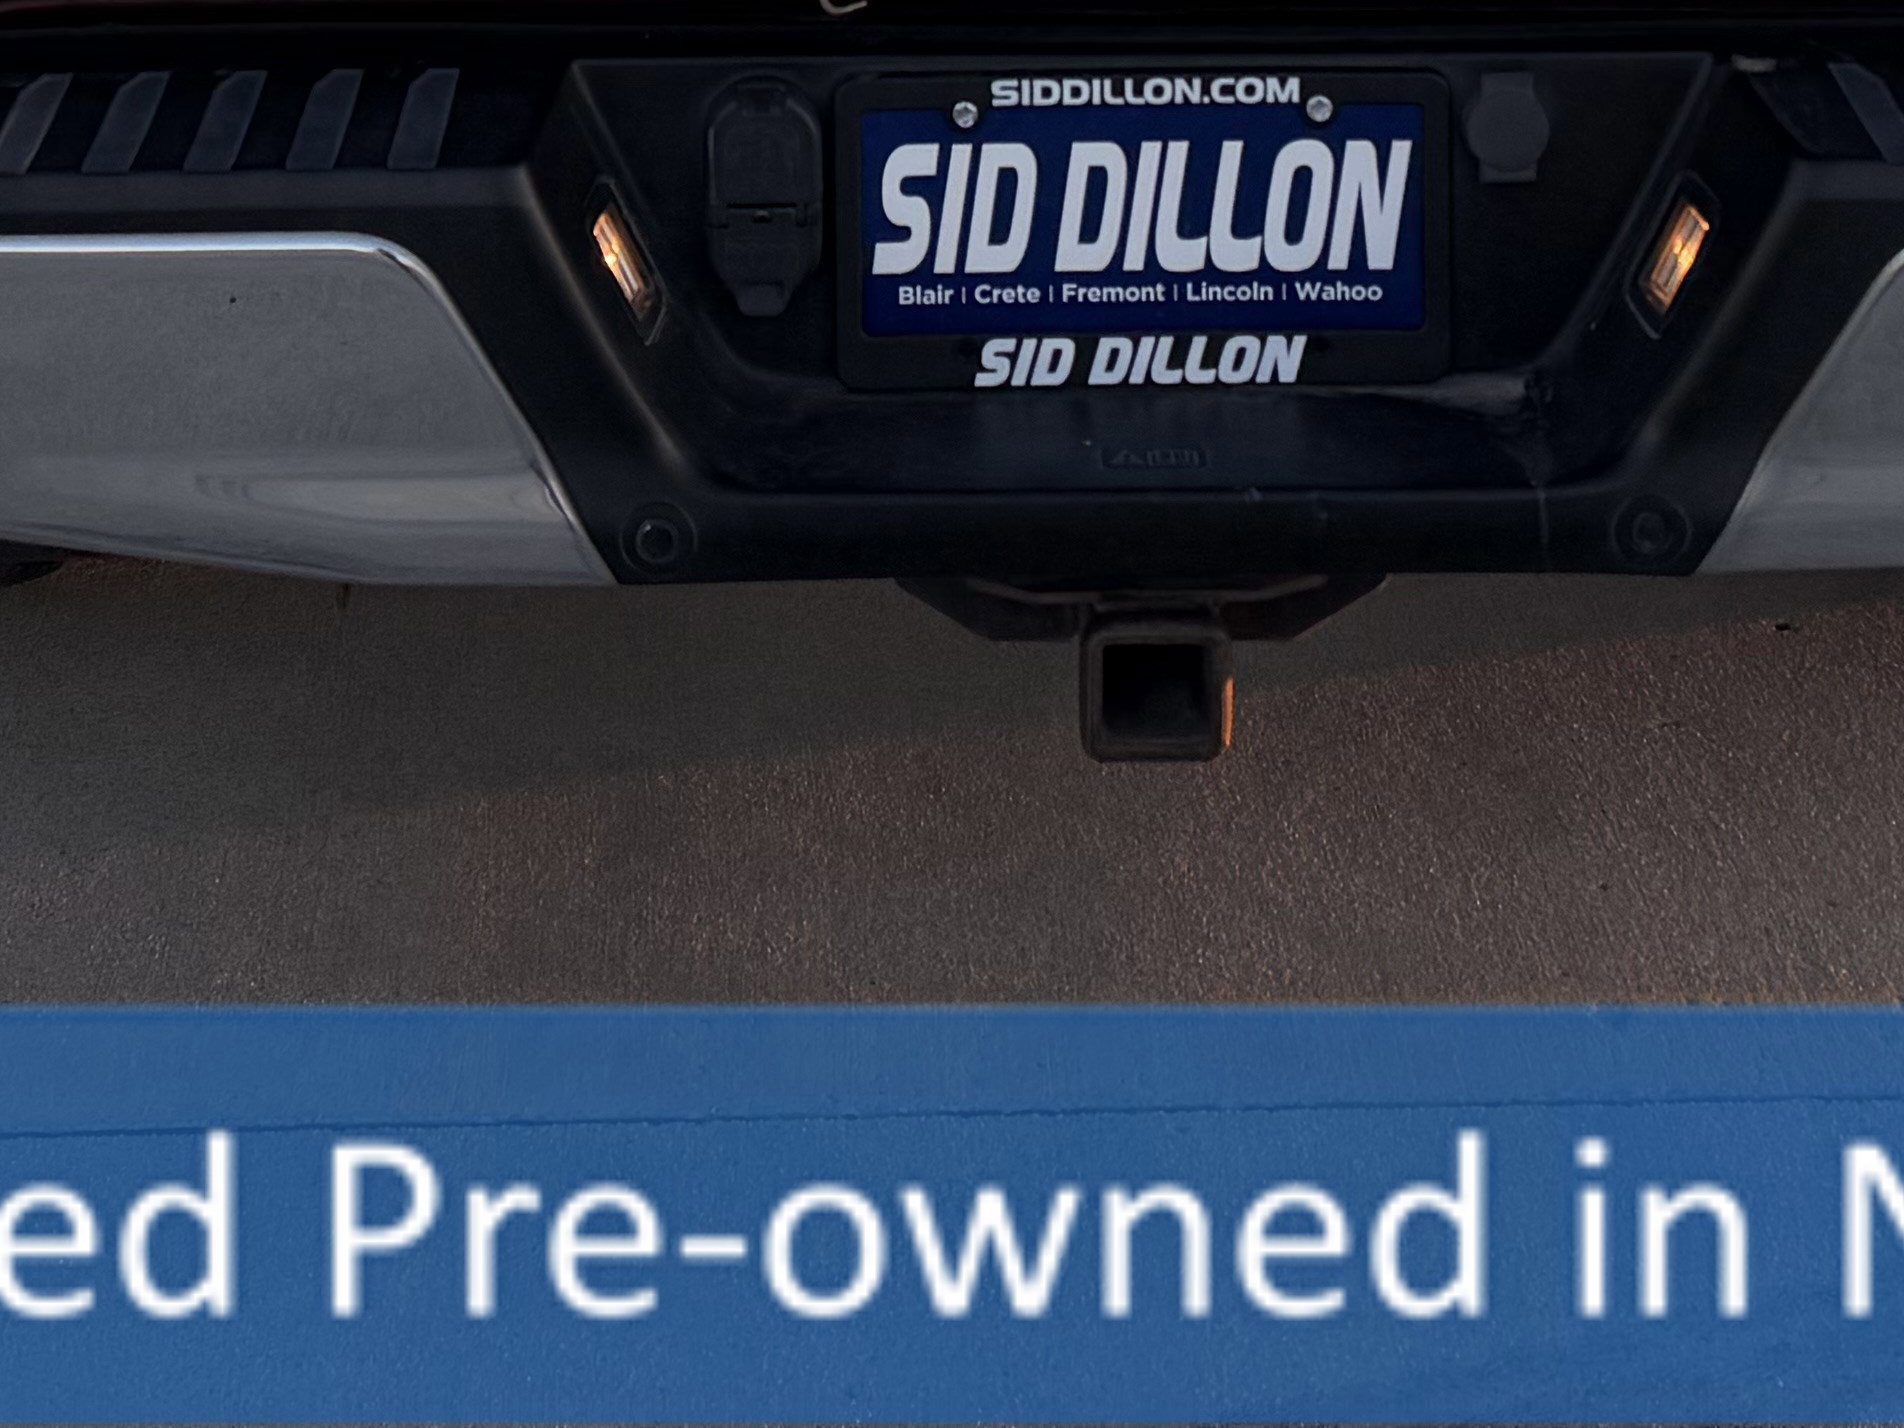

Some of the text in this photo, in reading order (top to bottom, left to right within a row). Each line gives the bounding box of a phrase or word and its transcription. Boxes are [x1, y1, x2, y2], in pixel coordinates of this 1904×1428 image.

[990, 75, 1301, 108] SIDDILLON.COM
[872, 139, 1413, 275] SID DILLON
[898, 280, 1384, 306] Blair Crete Fremont Lincoln Wahoo
[973, 335, 1309, 388] SID DILLON
